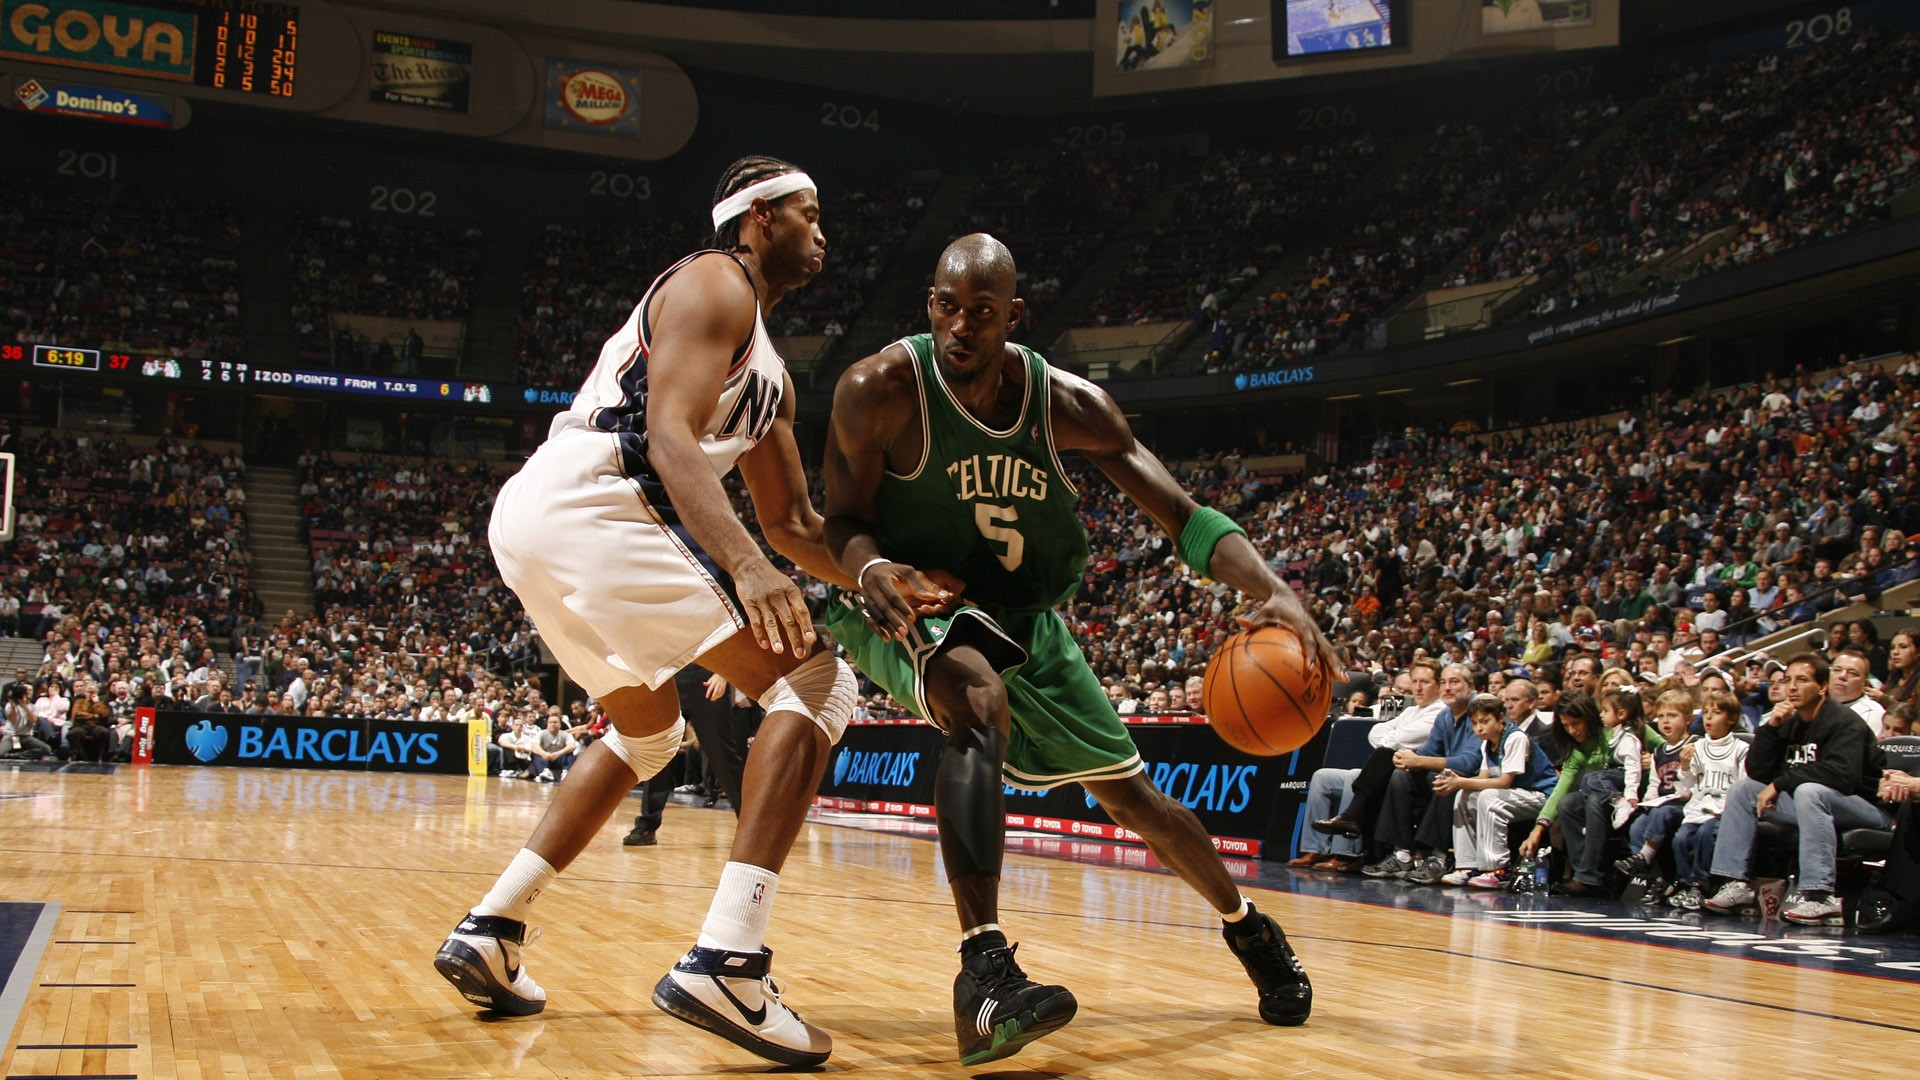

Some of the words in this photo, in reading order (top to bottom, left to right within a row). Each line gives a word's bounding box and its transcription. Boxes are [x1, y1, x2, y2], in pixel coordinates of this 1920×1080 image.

[10, 4, 184, 65] GOYA
[224, 11, 230, 25] 1
[286, 20, 296, 35] 5
[1191, 7, 1210, 62] ZOD
[1785, 6, 1852, 49] 208
[217, 25, 228, 41] 0
[246, 30, 256, 45] 0
[279, 34, 297, 50] 11
[237, 44, 255, 60] 12
[272, 48, 295, 65] 20
[215, 57, 226, 71] 2
[243, 60, 254, 75] 3
[271, 64, 295, 81] 34
[374, 62, 413, 81] The
[1536, 65, 1594, 97] 207
[241, 76, 253, 91] 5
[270, 80, 294, 96] 50
[576, 80, 622, 102] MEGA
[56, 90, 138, 115] Domino's
[820, 101, 880, 132] 204
[1296, 102, 1357, 130] 206
[1066, 122, 1126, 149] 205
[56, 149, 118, 179] 201
[590, 170, 651, 200] 203
[369, 185, 436, 217] 202
[1601, 308, 1614, 321] the
[1616, 300, 1640, 318] world
[47, 349, 84, 365] 6:19
[108, 354, 129, 369] 37
[202, 368, 212, 380] 2
[221, 370, 231, 382] 5
[238, 372, 245, 383] 1
[254, 370, 292, 384] IZOD
[295, 374, 338, 386] POINTS
[344, 378, 377, 389] FROM
[440, 383, 449, 396] 6
[1250, 366, 1313, 387] BARCLAYS
[975, 502, 1024, 572] 5
[238, 726, 439, 765] BARCLAYS
[847, 751, 920, 787] BARCLAYS
[1144, 762, 1258, 813] RCLAYS
[1280, 781, 1307, 790] MARQUIS
[1081, 824, 1102, 835] TOYOTA
[1222, 840, 1248, 851] TOYOTA
